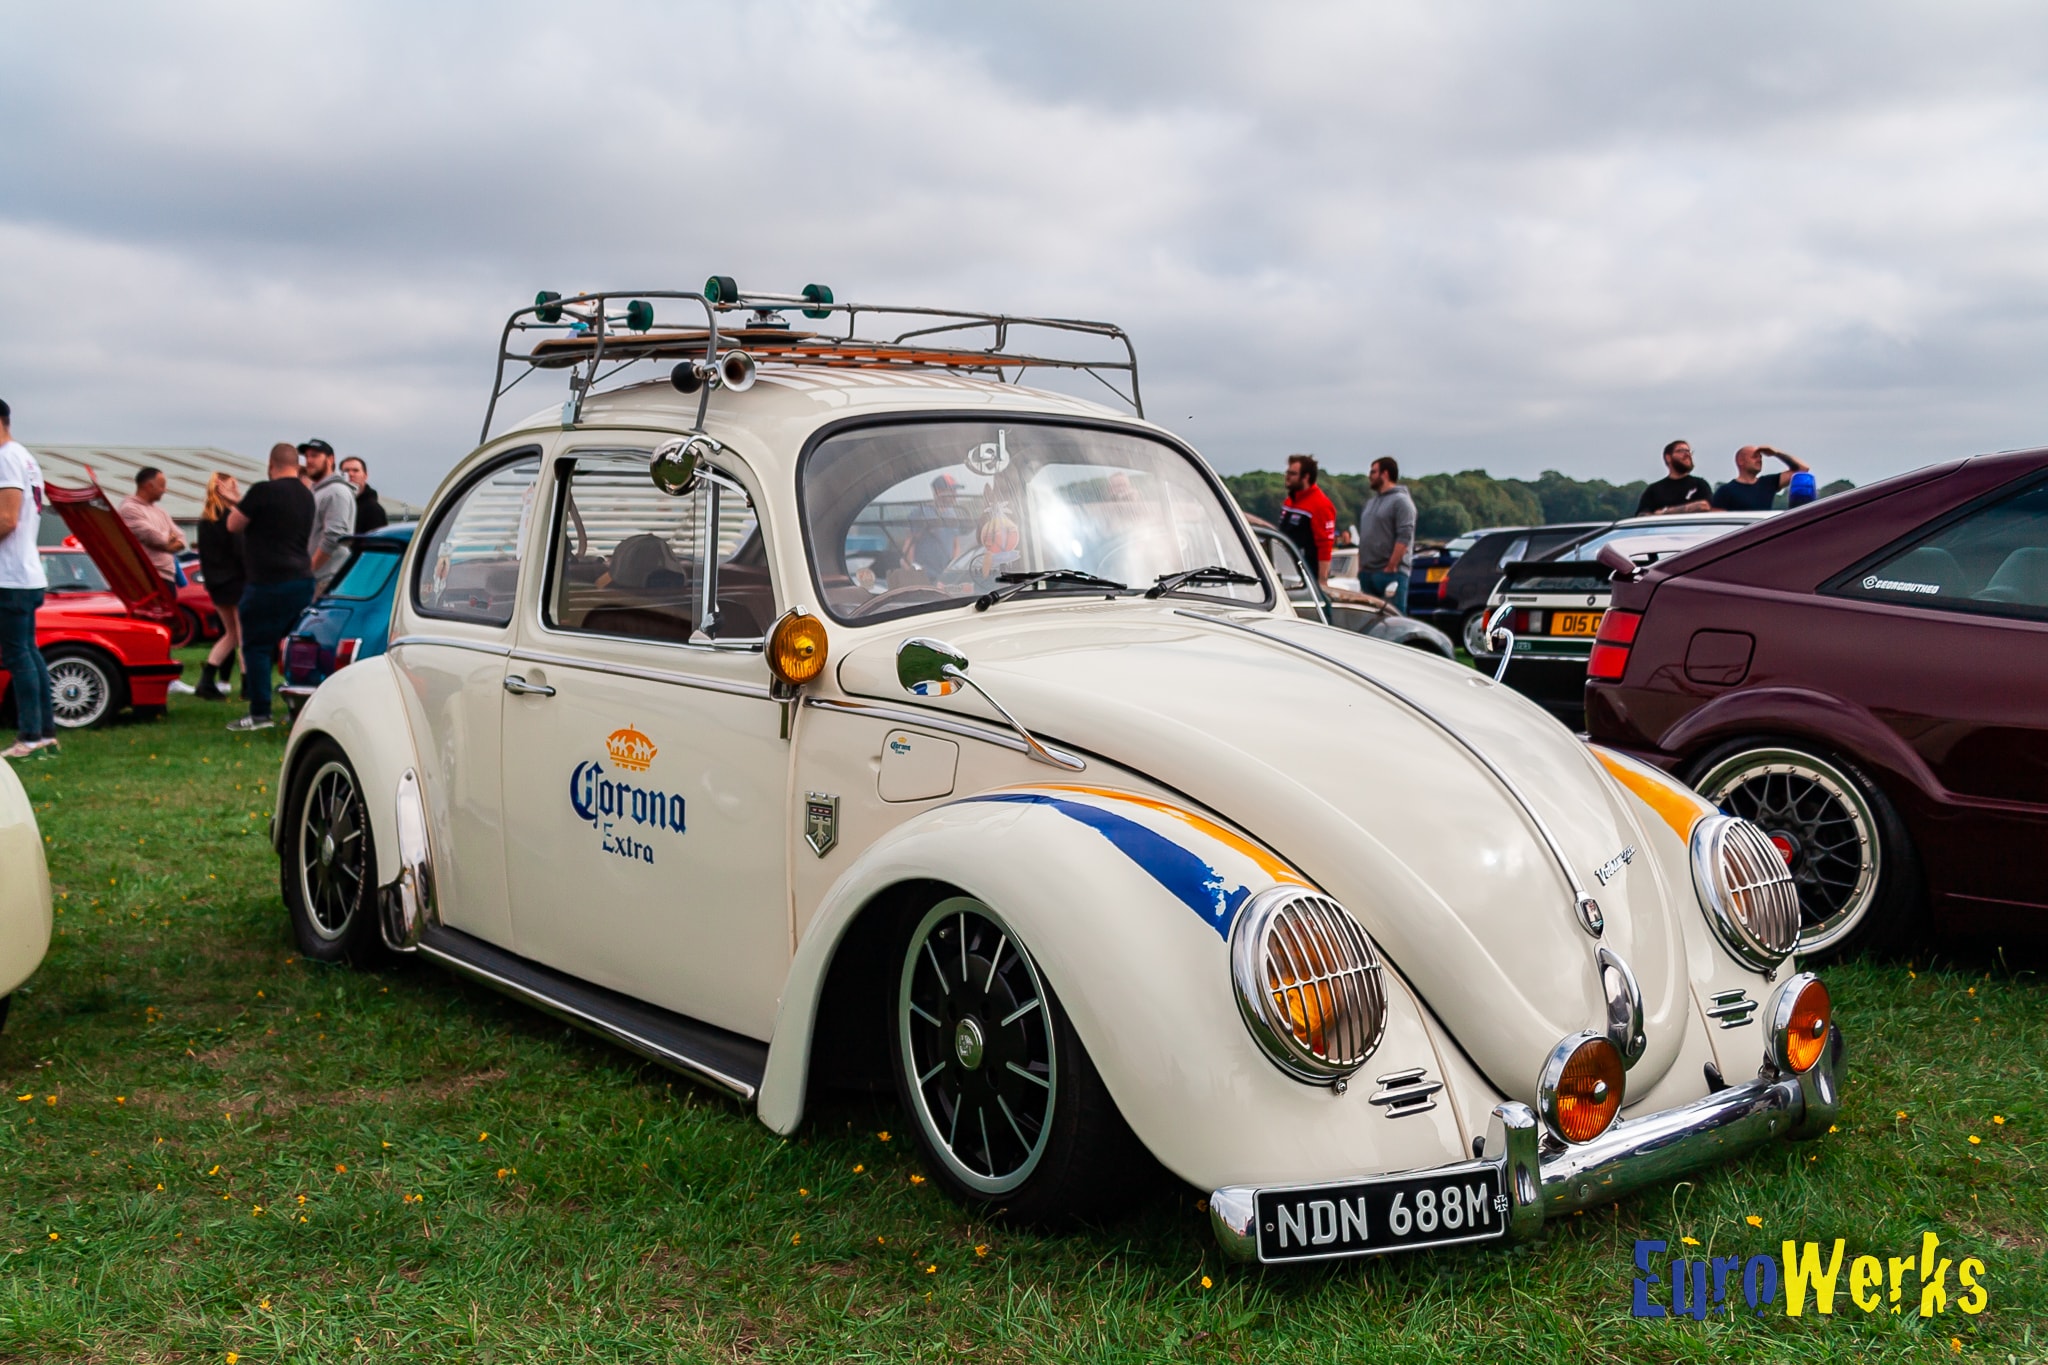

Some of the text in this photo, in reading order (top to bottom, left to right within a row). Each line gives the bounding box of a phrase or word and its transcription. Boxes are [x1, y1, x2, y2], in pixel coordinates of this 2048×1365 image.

[570, 760, 686, 834] Corona
[602, 822, 654, 865] Extra
[1277, 1183, 1492, 1248] NDN 688M
